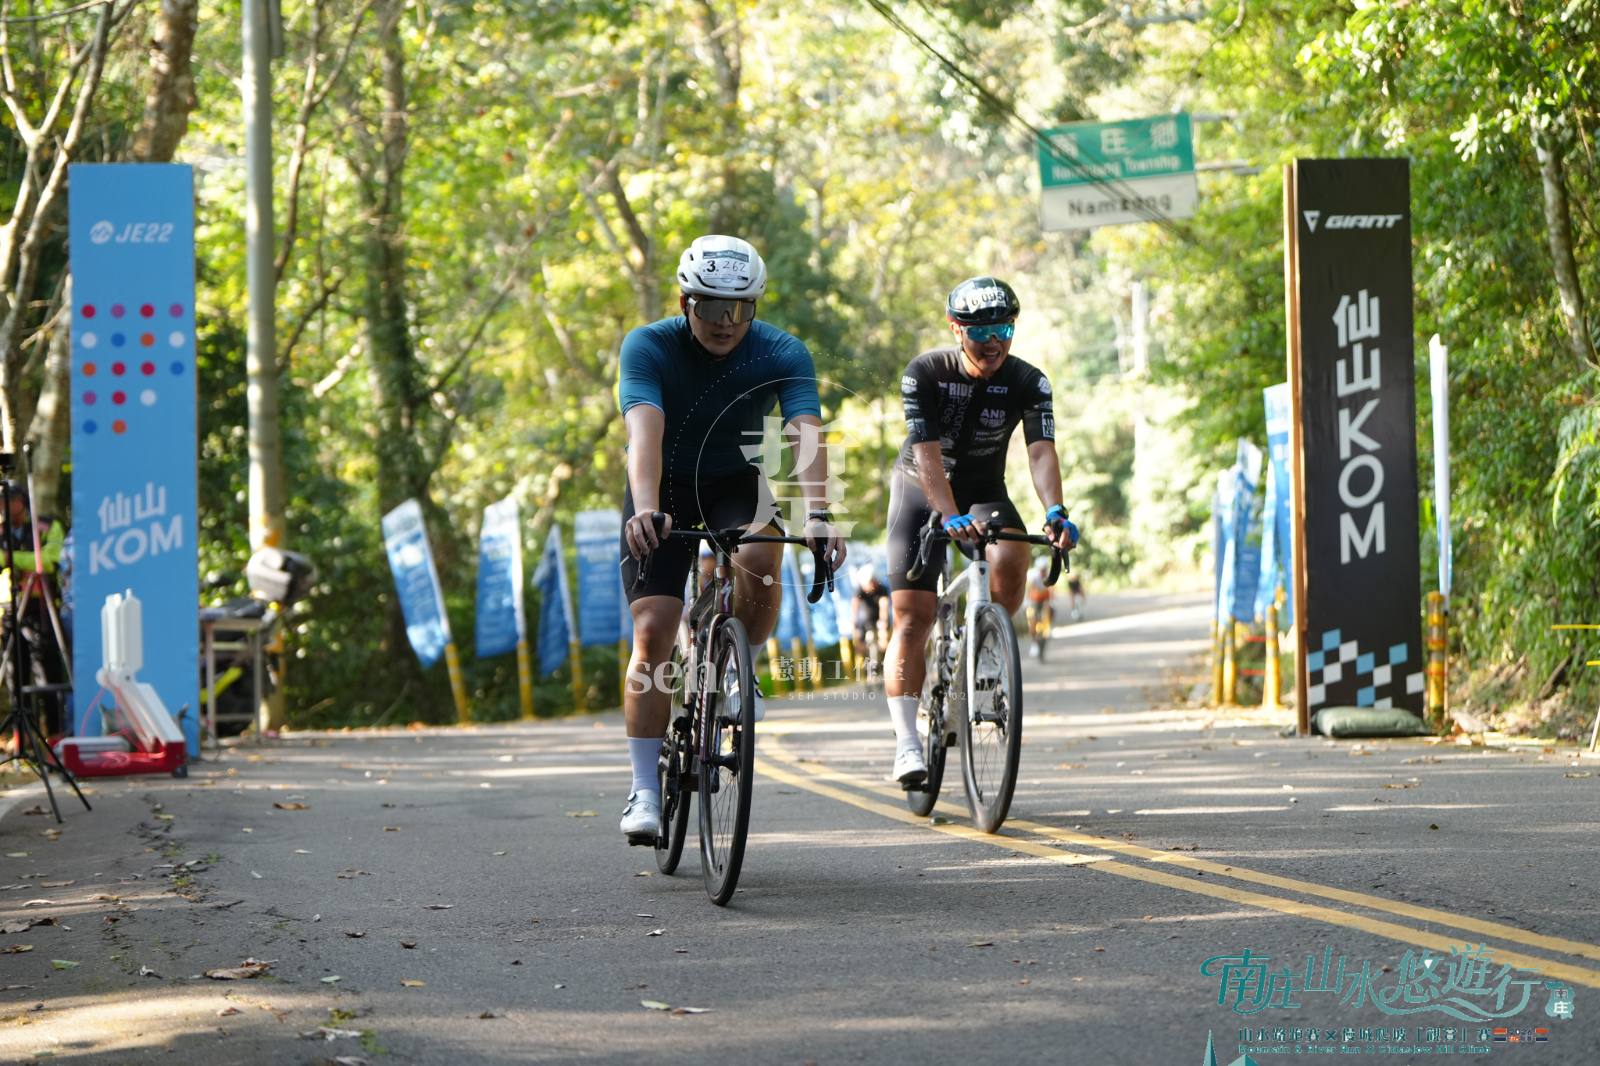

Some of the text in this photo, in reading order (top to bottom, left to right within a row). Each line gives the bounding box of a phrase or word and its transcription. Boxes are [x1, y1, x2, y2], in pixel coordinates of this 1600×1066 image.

[115, 223, 174, 244] JE22
[1325, 214, 1403, 230] GIANT
[97, 482, 166, 533] 仙山
[1338, 398, 1386, 566] KOM
[89, 514, 183, 575] KOM
